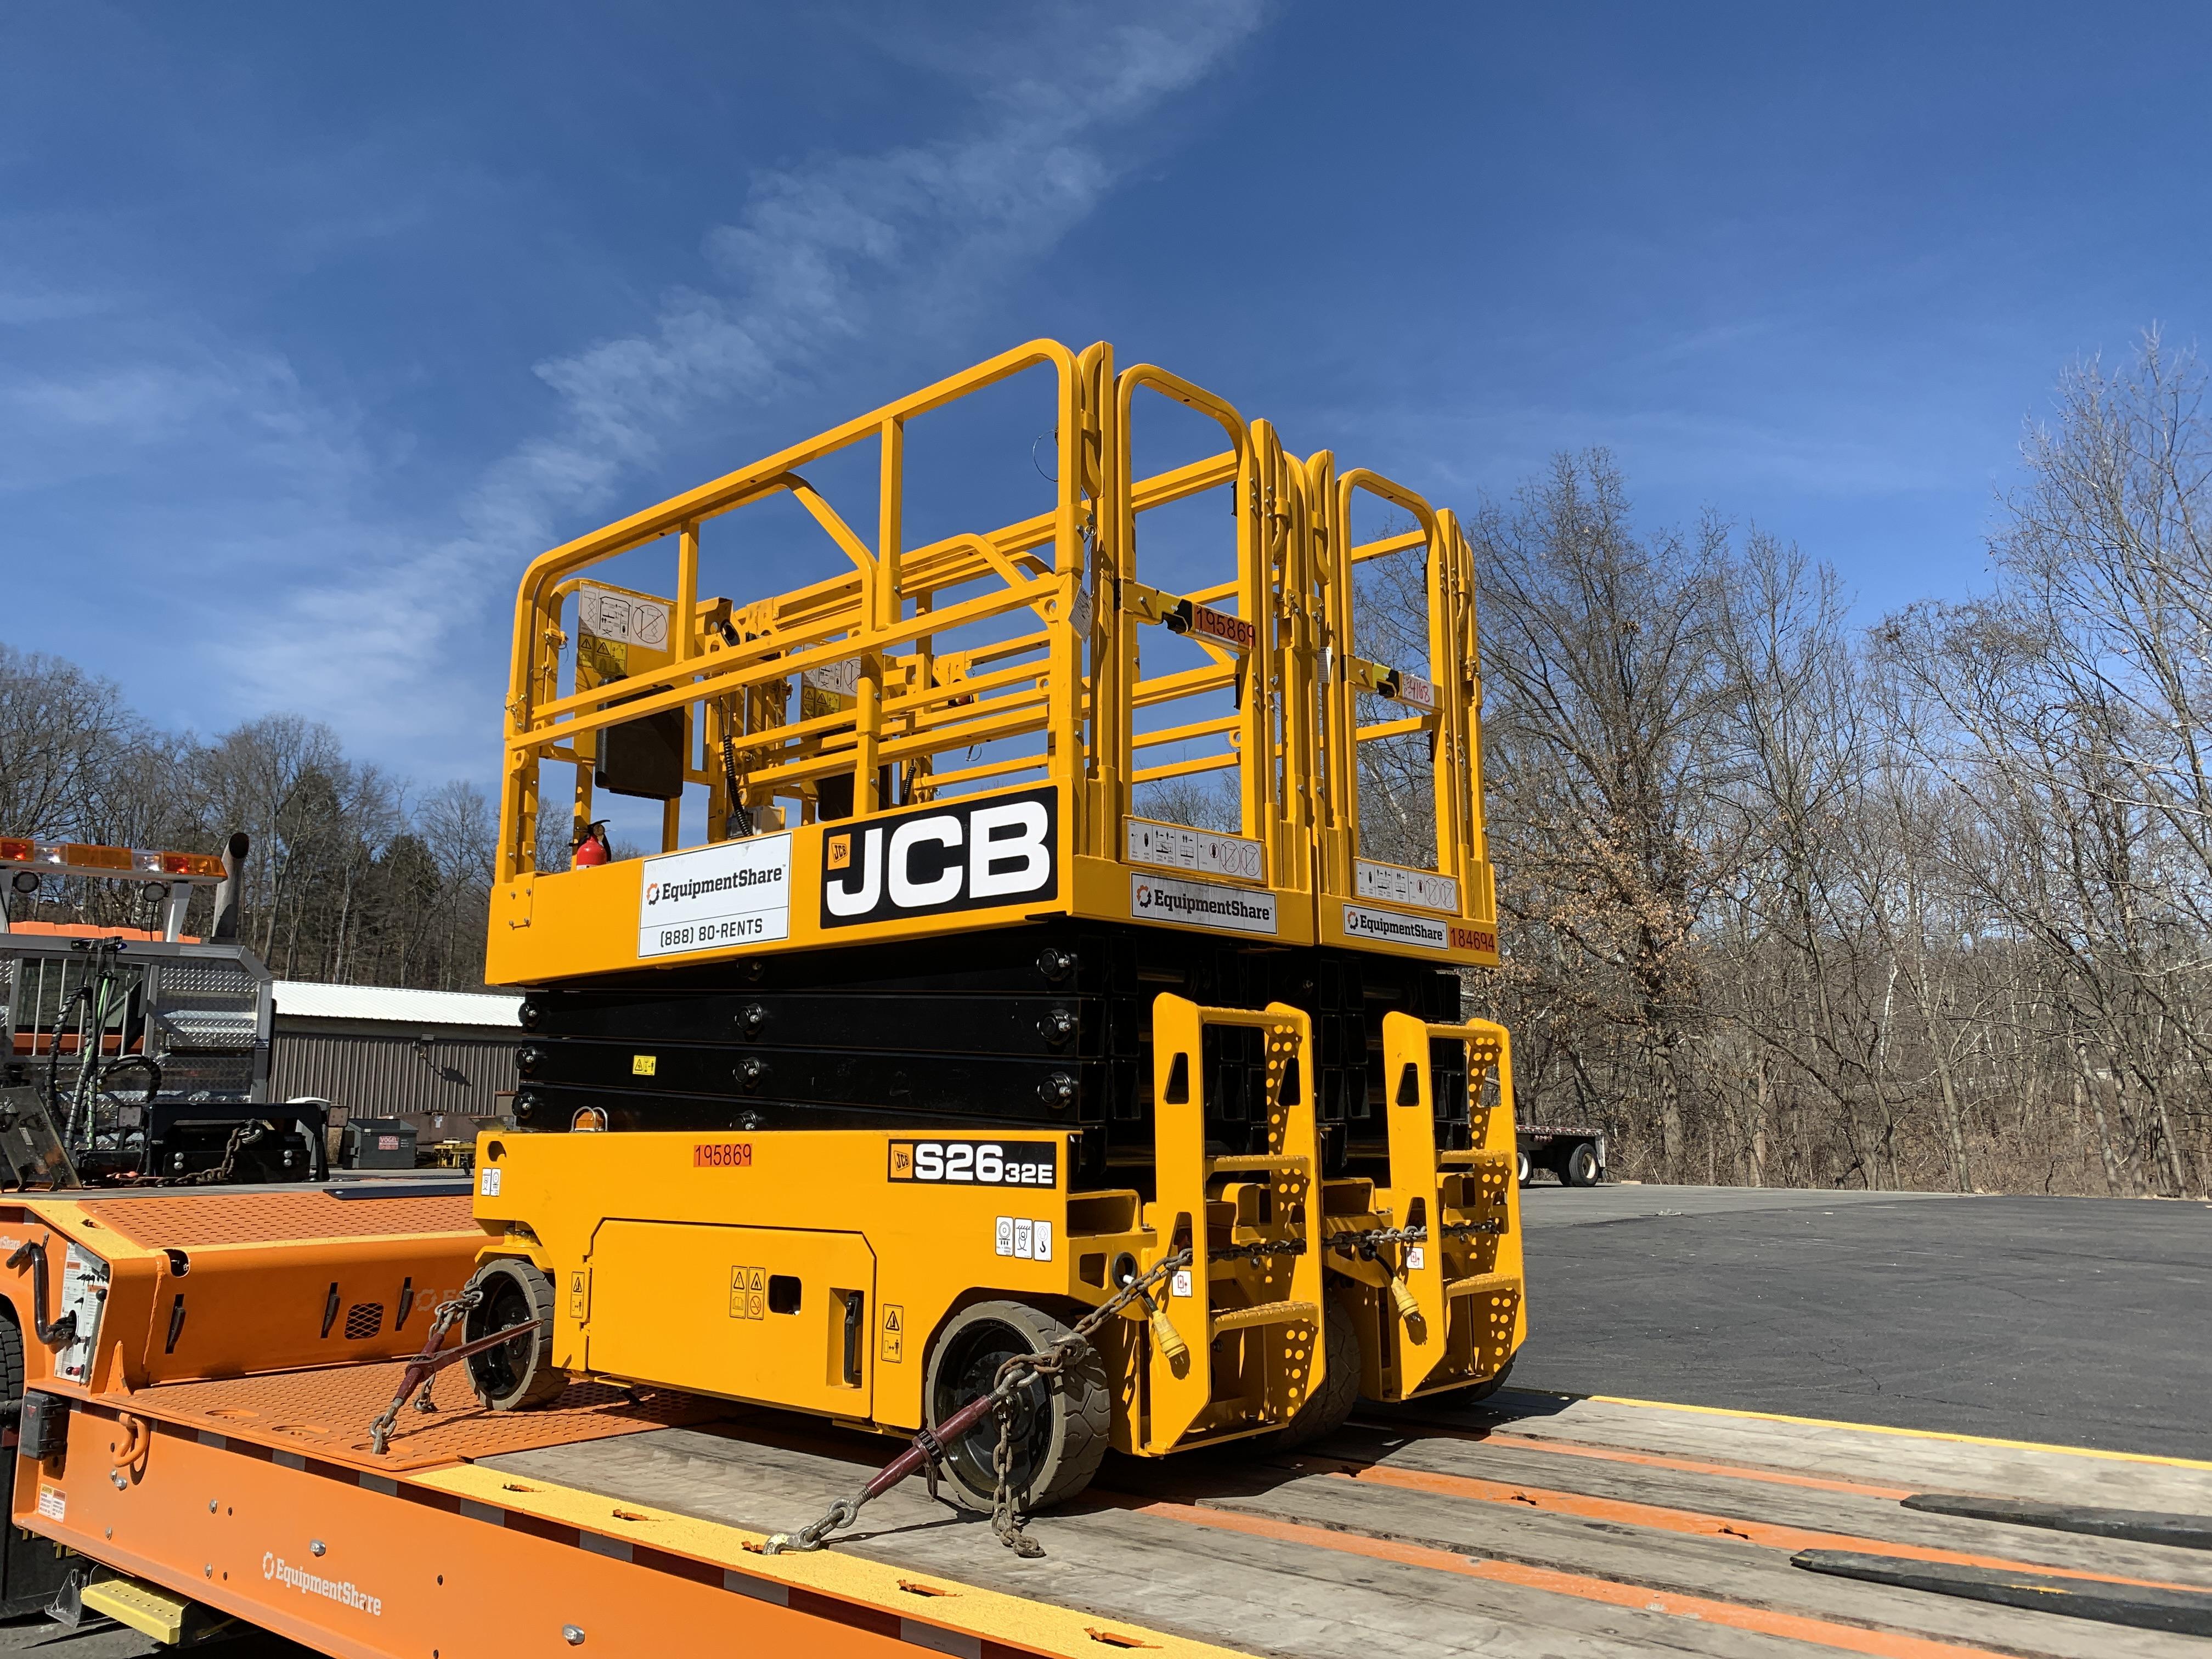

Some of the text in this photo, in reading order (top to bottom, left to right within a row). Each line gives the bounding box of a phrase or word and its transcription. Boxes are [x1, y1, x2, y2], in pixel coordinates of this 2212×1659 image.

[1197, 607, 1256, 646] 195869
[827, 801, 1050, 916] JCB
[834, 845, 847, 860] JCB
[662, 867, 782, 902] EquipmentShare
[1154, 889, 1269, 920] EquipmentShare
[660, 918, 763, 947] (888) 80-RENTS
[1359, 915, 1443, 941] EquipmentShare
[1451, 928, 1495, 952] 184694
[696, 1144, 751, 1166] 195869
[896, 1143, 1053, 1184] JCB S26 32E
[275, 1558, 382, 1616] EquipmentShare
